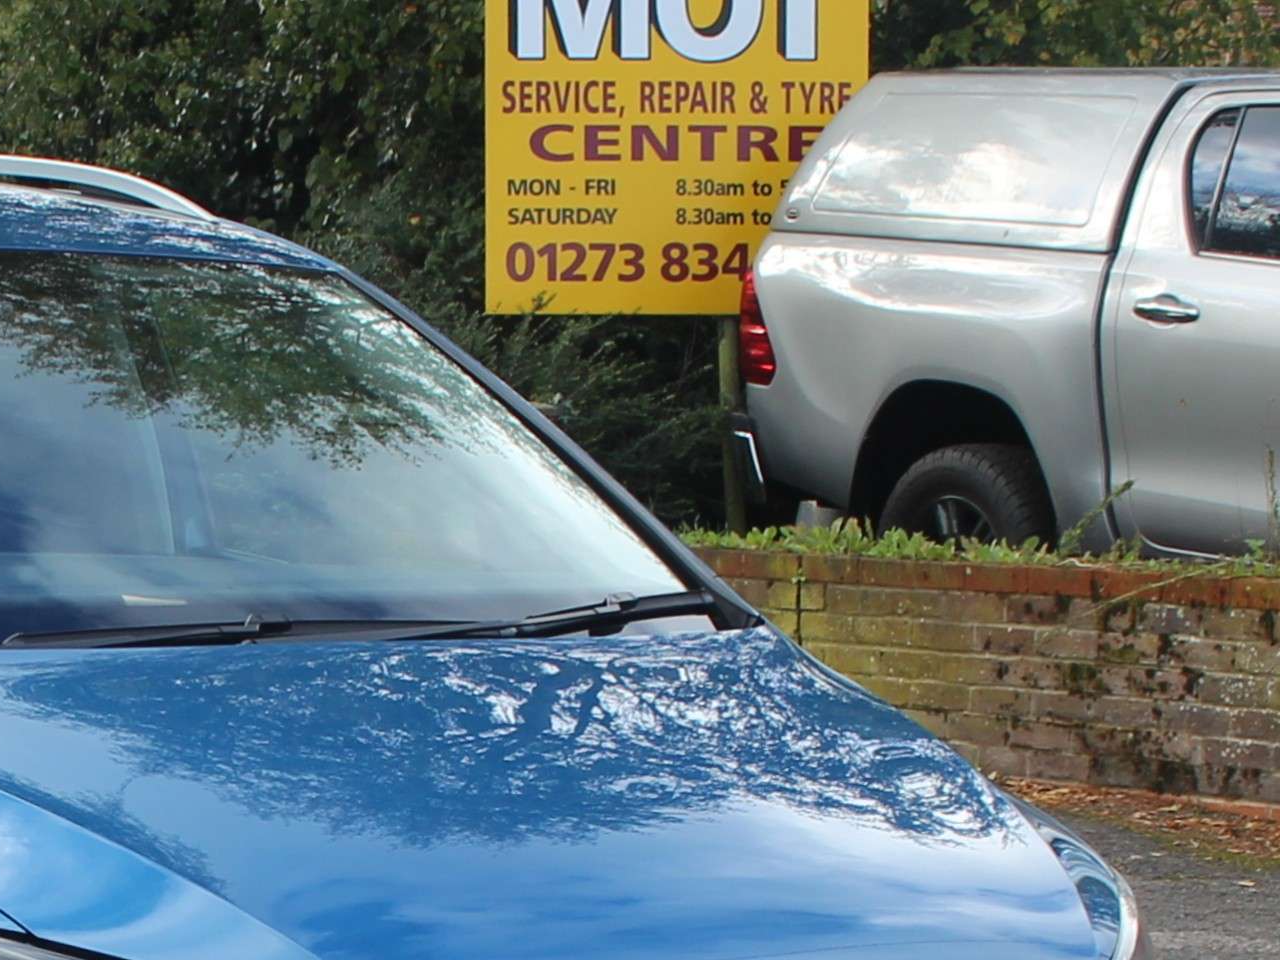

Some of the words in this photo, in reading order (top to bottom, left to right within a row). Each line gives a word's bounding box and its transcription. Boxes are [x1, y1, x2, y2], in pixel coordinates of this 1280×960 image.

[501, 80, 625, 118] SERVICE,
[639, 81, 736, 114] REPAIR
[749, 81, 768, 114] &
[507, 179, 561, 196] MON
[584, 179, 616, 196] FRI
[675, 179, 745, 196] 8.30am
[752, 181, 772, 196] to
[507, 208, 618, 225] SATURDAY
[675, 208, 745, 225] 8.30am
[752, 210, 772, 225] to
[505, 242, 646, 282] 01273
